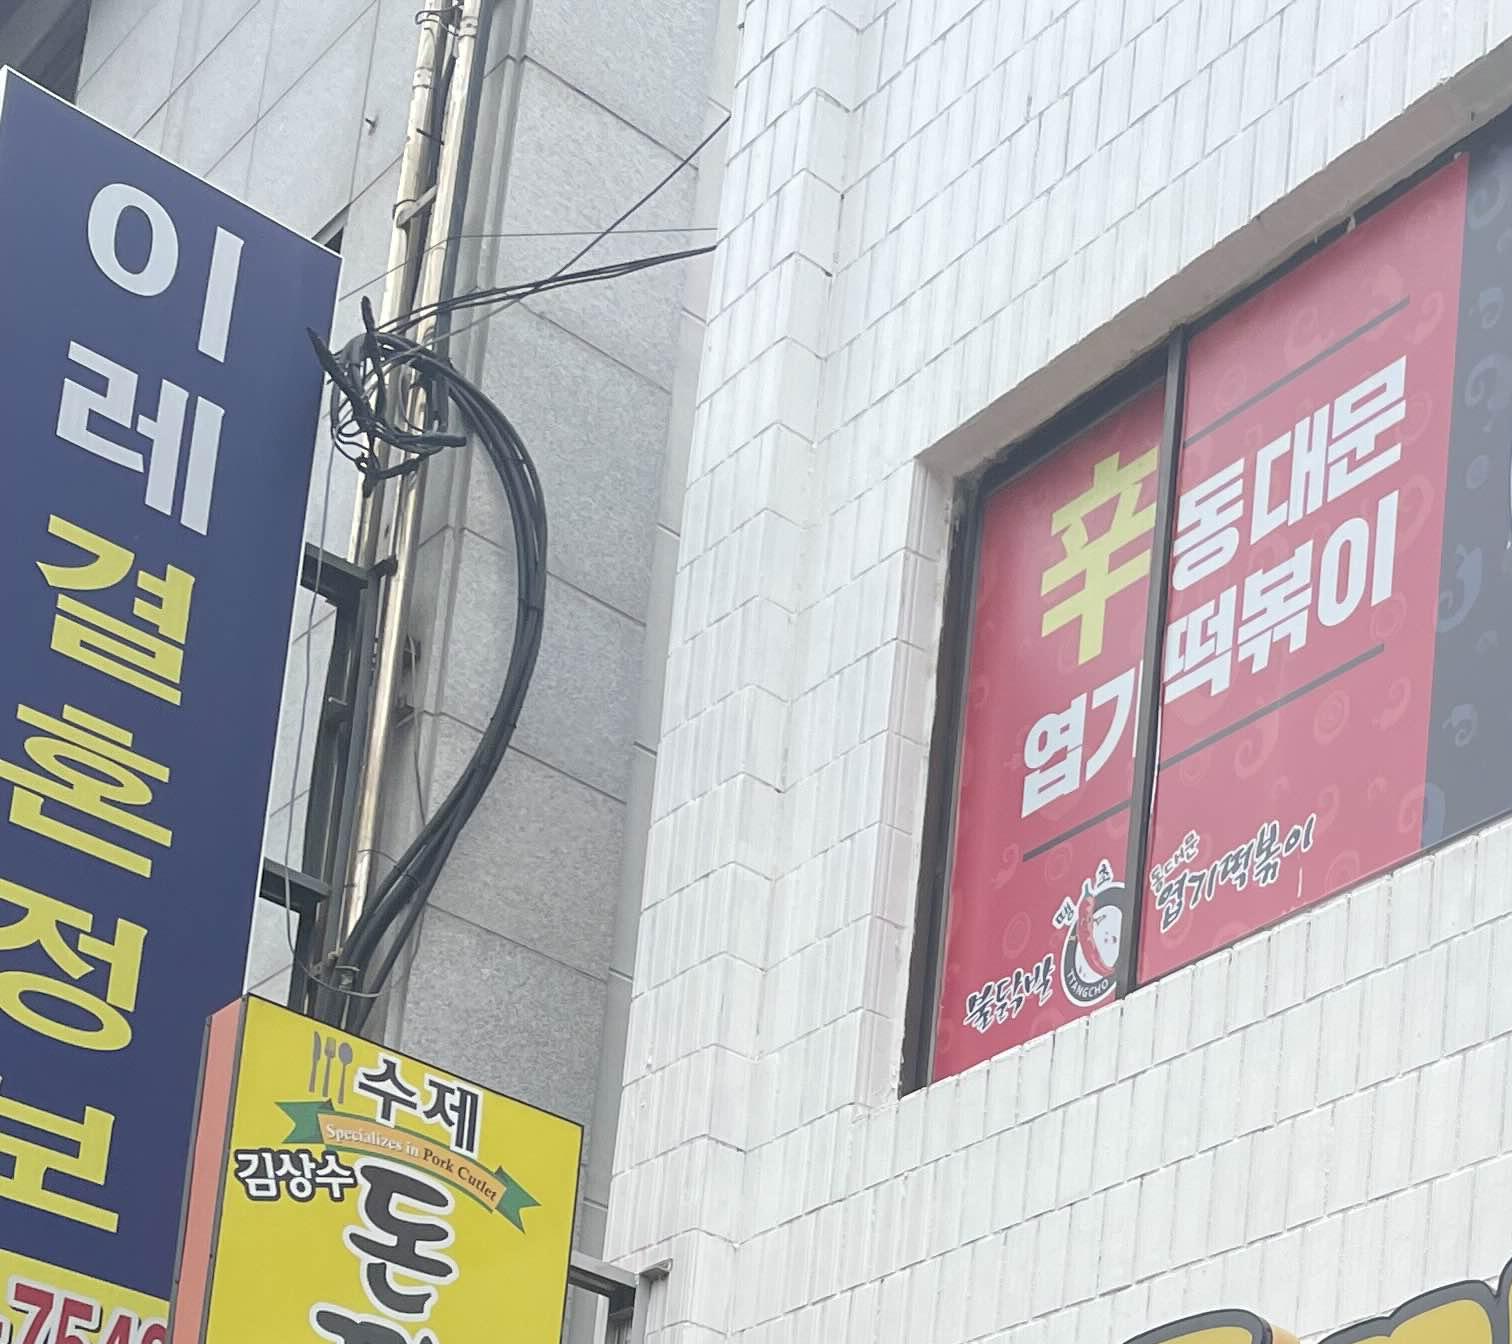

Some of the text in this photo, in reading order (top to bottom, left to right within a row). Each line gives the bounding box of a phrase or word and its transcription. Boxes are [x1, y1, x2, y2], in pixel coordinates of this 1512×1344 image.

[55, 182, 245, 537] 이레
[1171, 355, 1407, 594] 동대문
[1041, 445, 1158, 666] 辛
[1150, 831, 1200, 892] 동대문
[1155, 813, 1317, 933] 엽기떡볶이
[356, 1057, 481, 1156] 수제
[237, 1150, 356, 1200] 김상수
[326, 1122, 498, 1203] Specializes in Pork Cutlet
